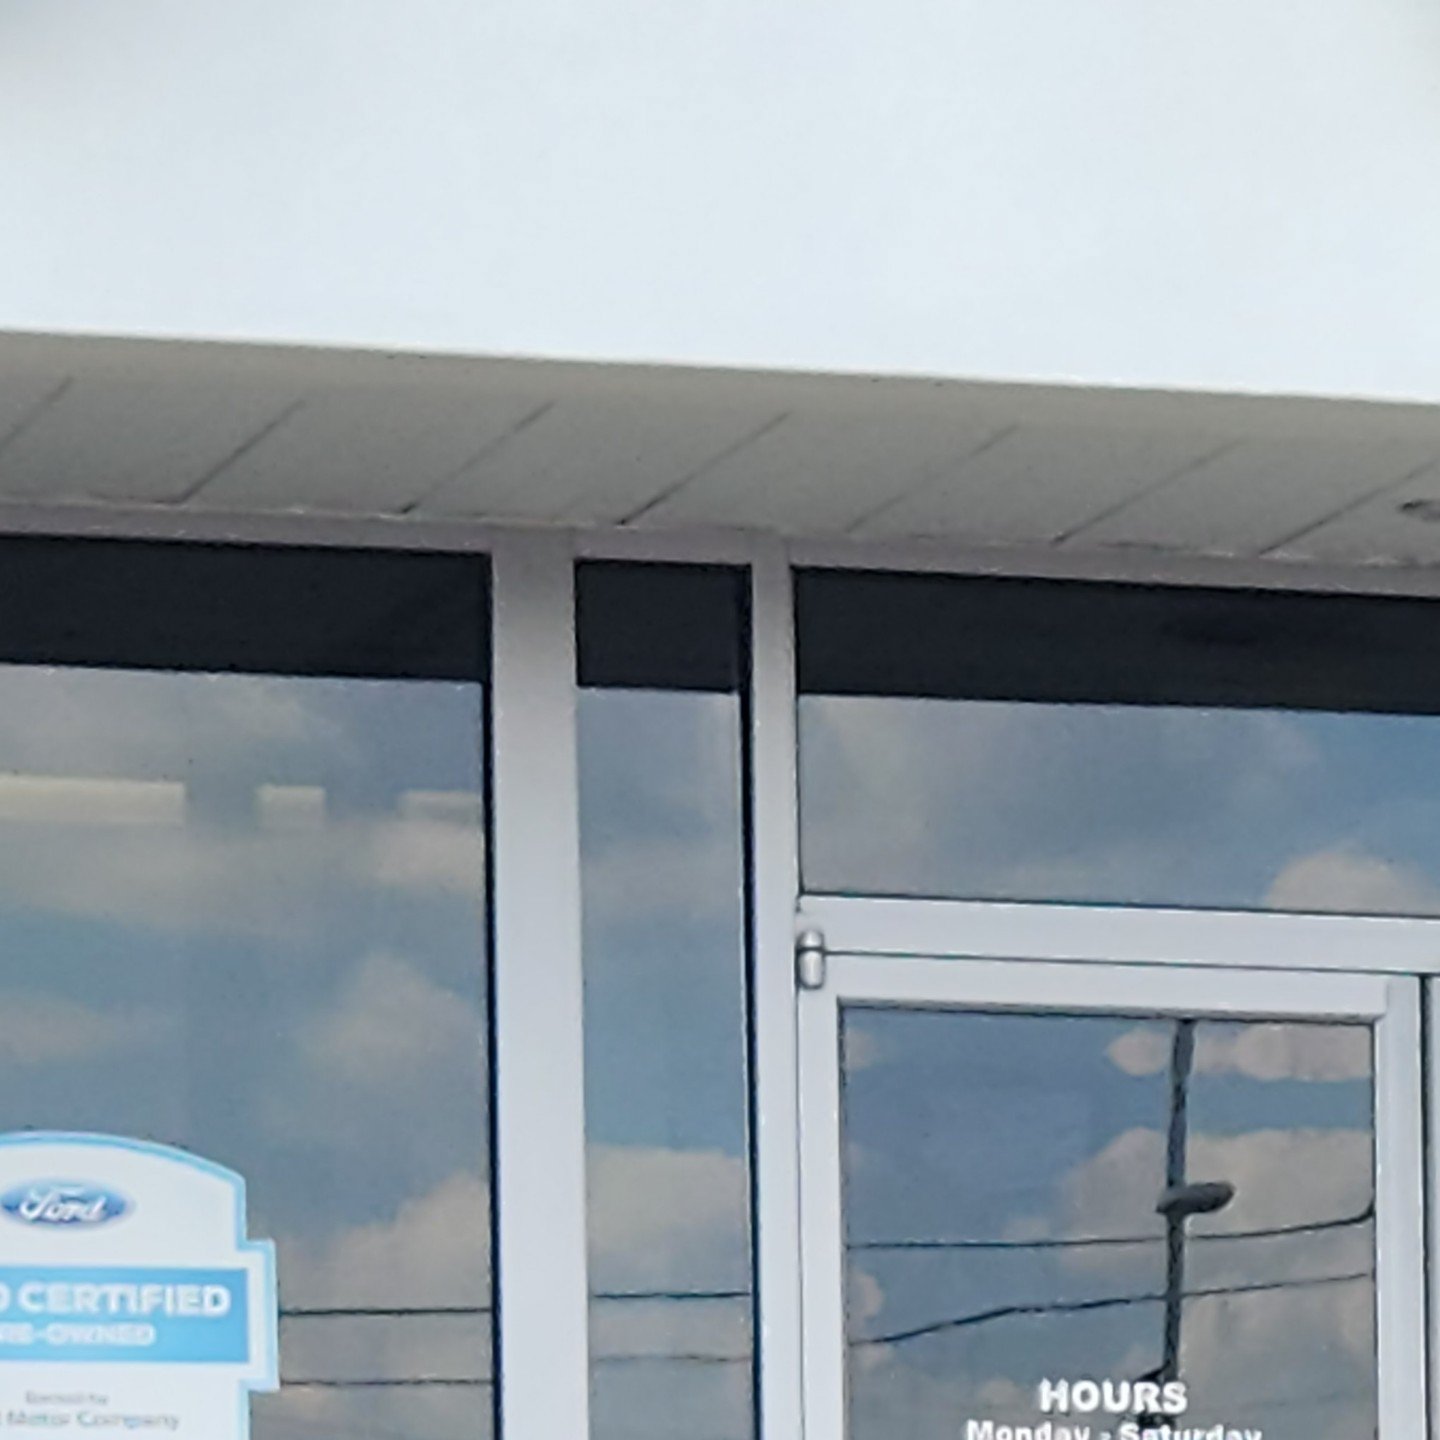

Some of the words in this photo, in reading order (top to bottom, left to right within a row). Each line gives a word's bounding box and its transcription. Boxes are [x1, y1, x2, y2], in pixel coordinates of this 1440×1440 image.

[18, 1185, 108, 1223] Ford
[17, 1282, 231, 1317] CERTIFIED
[1038, 1379, 1188, 1414] HOURS
